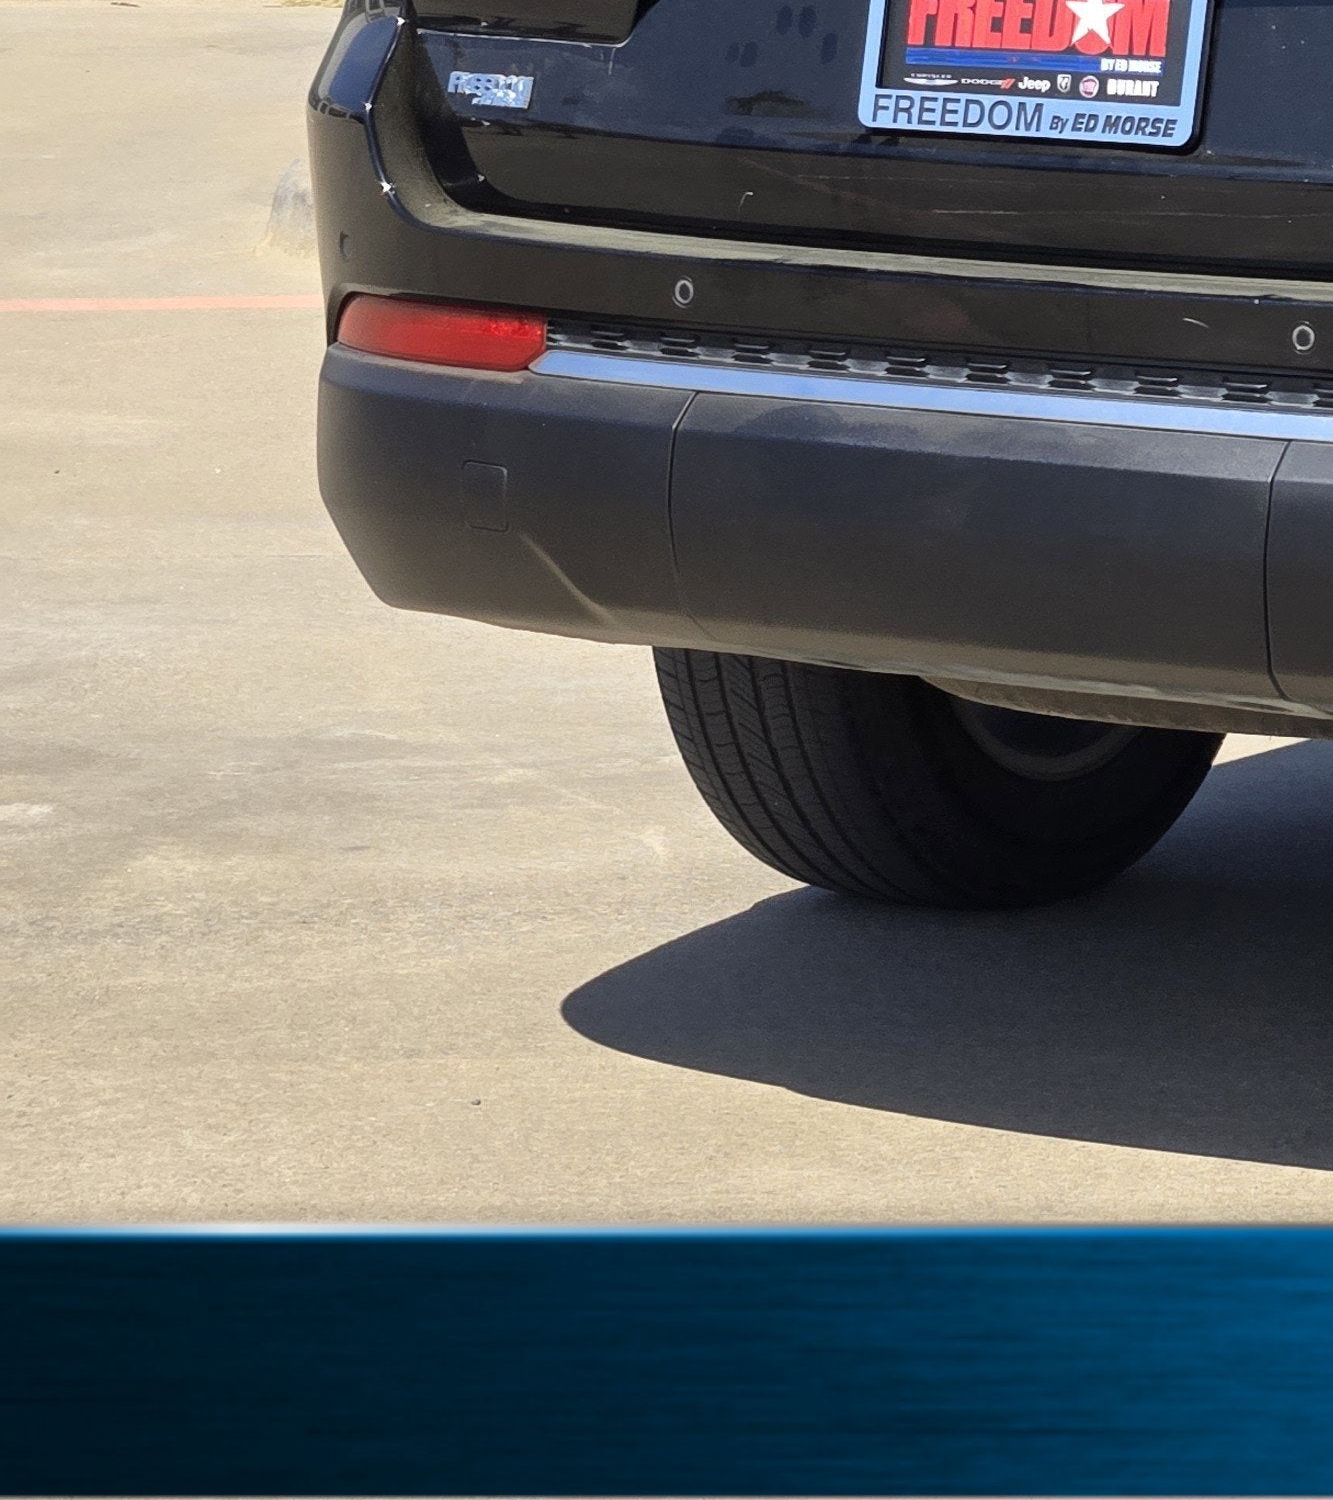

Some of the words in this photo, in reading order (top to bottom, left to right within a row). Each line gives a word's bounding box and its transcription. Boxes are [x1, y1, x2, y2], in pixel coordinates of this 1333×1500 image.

[1017, 76, 1051, 93] Jeep
[1106, 78, 1160, 98] DURANT
[871, 93, 1045, 133] FREEDOM
[1048, 115, 1069, 135] By
[1070, 113, 1099, 134] ED
[1100, 115, 1179, 139] MORSE
